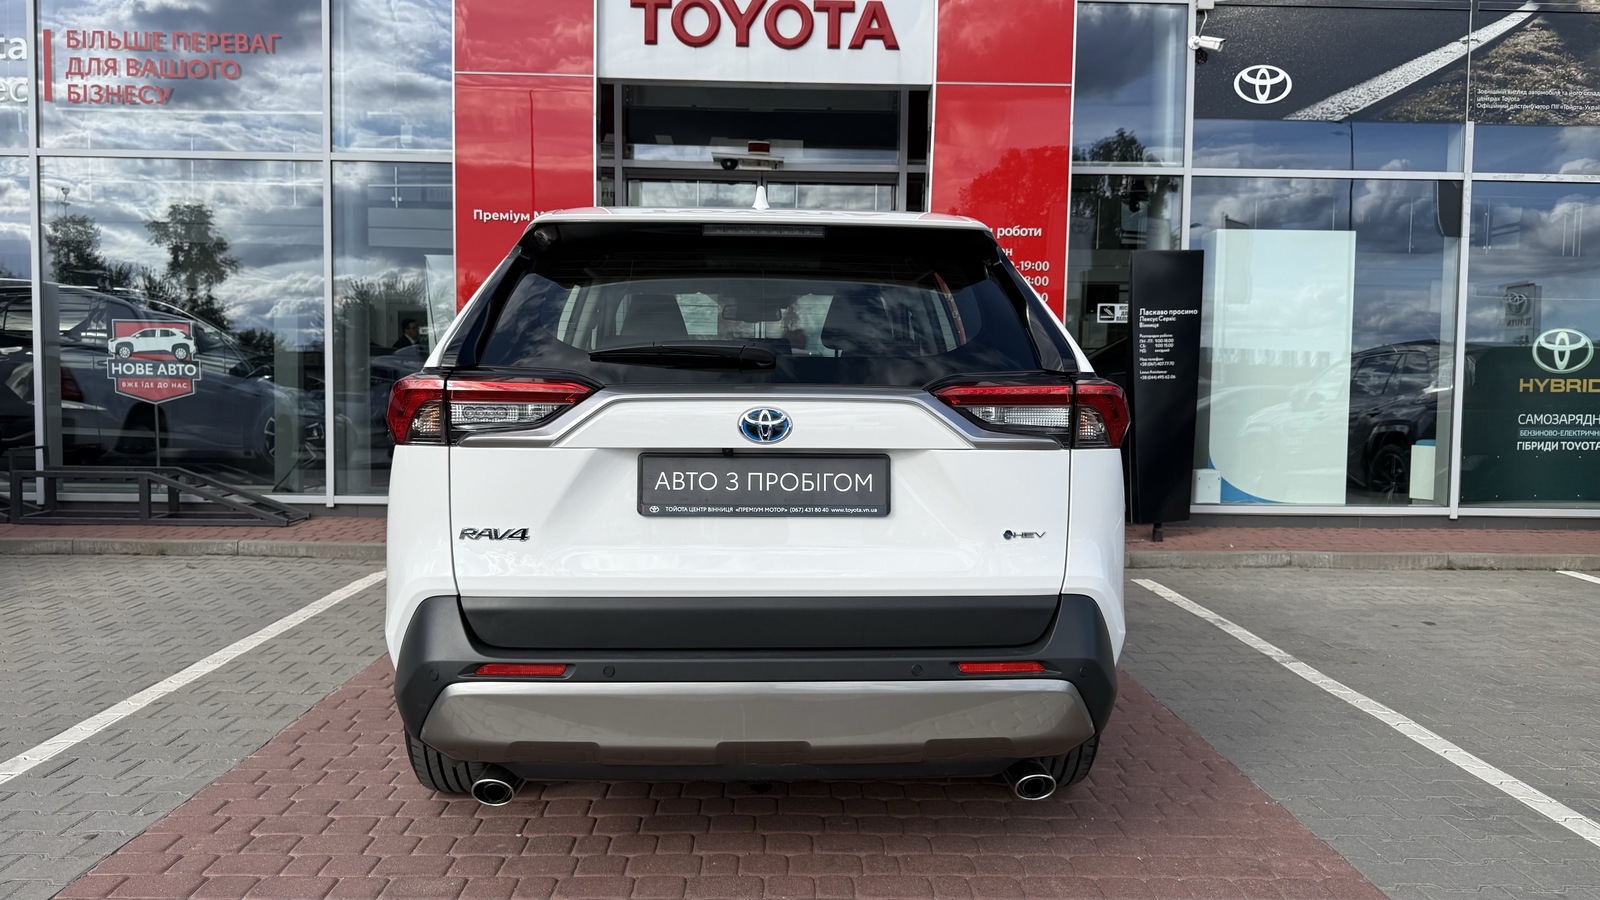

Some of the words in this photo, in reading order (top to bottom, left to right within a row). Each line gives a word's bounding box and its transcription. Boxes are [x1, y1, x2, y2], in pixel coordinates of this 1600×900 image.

[630, 0, 901, 50] TOYOTA
[66, 30, 165, 52] БІЛЬШЕ
[171, 31, 282, 53] ПЕРЕВАГ
[65, 57, 118, 79] ДЛЯ
[126, 58, 241, 79] ВАШОГО
[67, 84, 172, 104] БІЗНЕСУ
[473, 209, 531, 224] Преміум
[996, 224, 1042, 239] роботи
[1139, 308, 1169, 316] Ласкаво
[111, 362, 153, 375] НОВЕ
[157, 363, 197, 376] АВТО
[141, 381, 154, 389] ЇДЕ
[1518, 413, 1600, 427] САМОЗАРЯДН
[1516, 441, 1559, 452] ГІБРИДИ
[654, 471, 718, 491] АВТО
[725, 472, 739, 491] З
[747, 472, 873, 492] ПРОБІГОМ
[458, 527, 531, 542] RAV4
